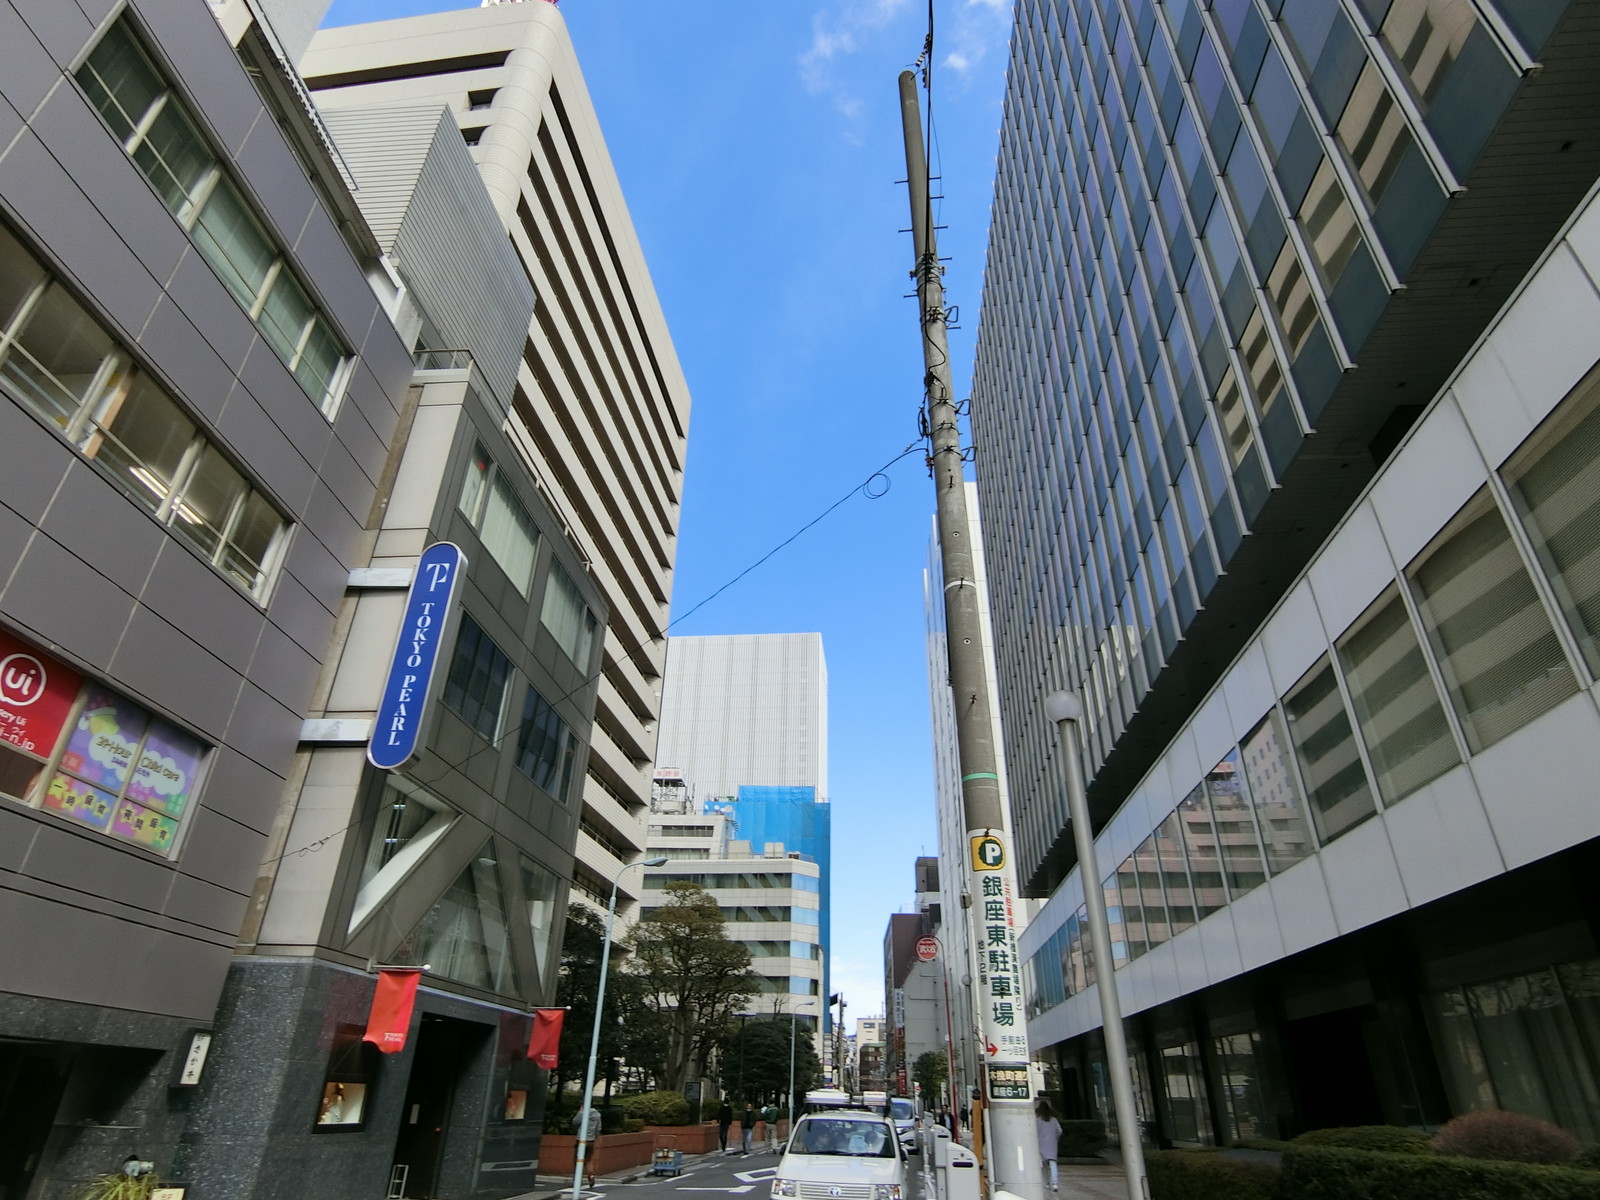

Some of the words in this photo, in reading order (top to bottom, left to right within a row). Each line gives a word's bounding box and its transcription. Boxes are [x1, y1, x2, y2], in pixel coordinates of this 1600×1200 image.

[406, 602, 435, 668] TOKYO
[387, 674, 416, 746] PEARL
[985, 843, 1001, 864] P
[982, 875, 1015, 1027] 銀座東駐車場
[993, 1086, 1027, 1096] 銀座6-17
